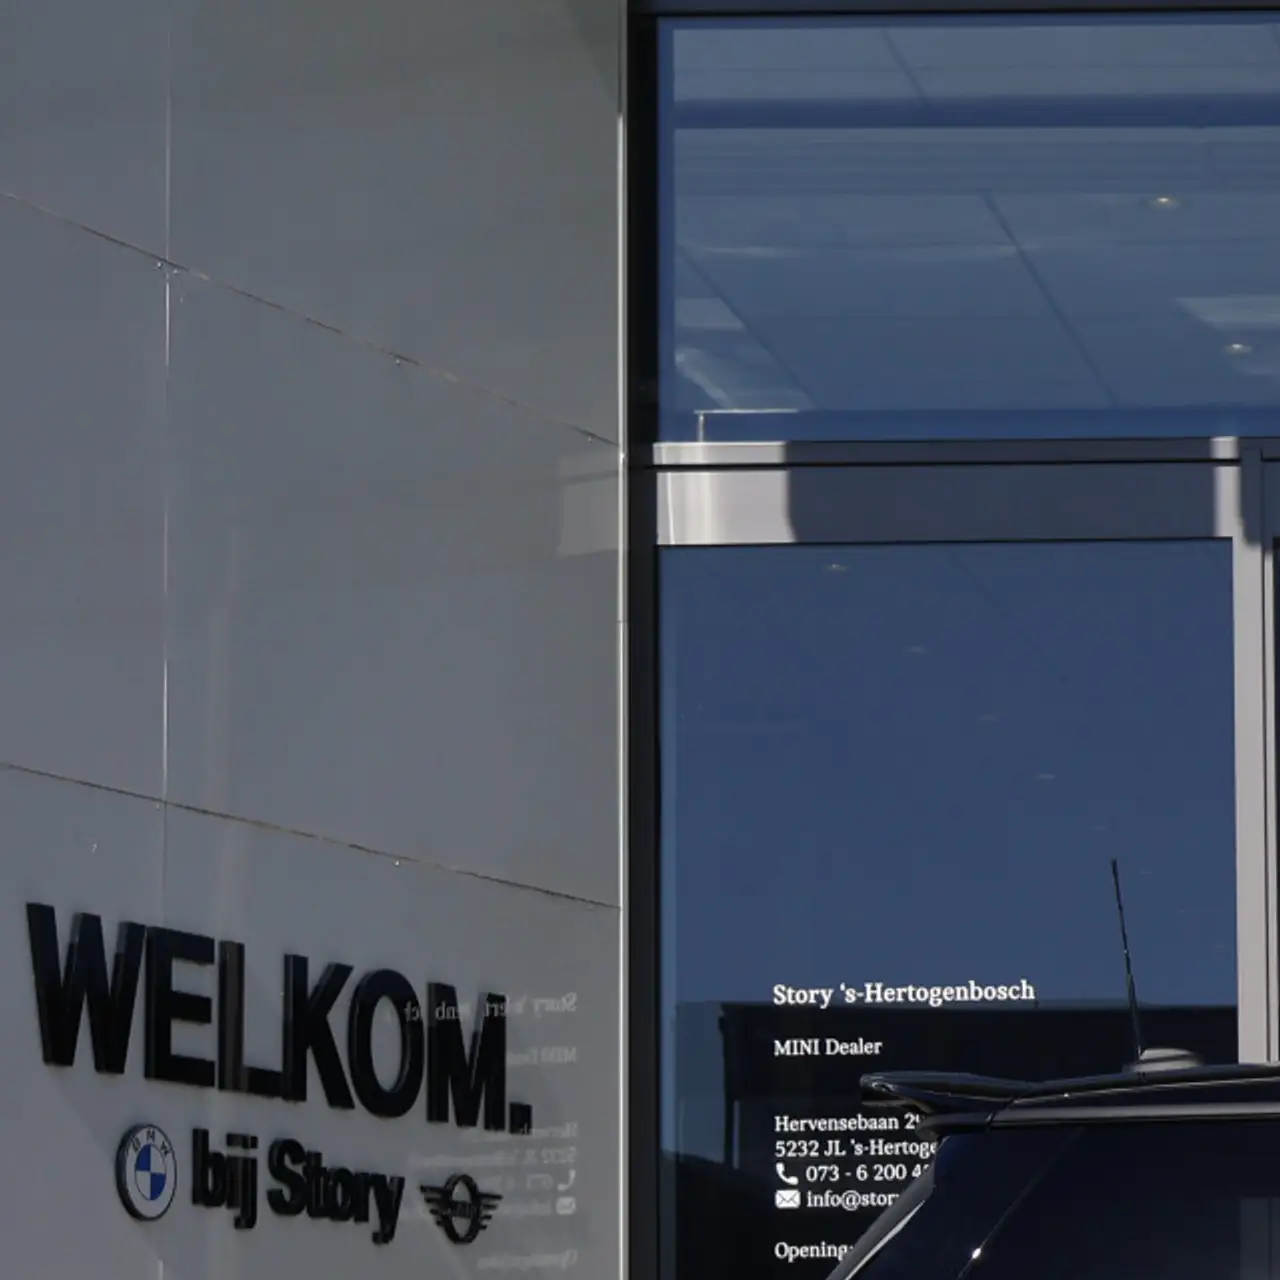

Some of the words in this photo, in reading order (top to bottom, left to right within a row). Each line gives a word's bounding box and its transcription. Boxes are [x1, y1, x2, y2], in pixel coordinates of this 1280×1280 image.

[773, 983, 834, 1009] Story
[839, 978, 1036, 1007] 's-Hertogenbosch
[26, 902, 533, 1135] WELKOM.
[774, 1038, 820, 1056] MINI
[825, 1037, 883, 1056] Dealer
[774, 1113, 899, 1133] Hervensebaan
[775, 1140, 820, 1158] 5232
[823, 1139, 847, 1157] JL
[805, 1164, 840, 1182] 073
[856, 1164, 869, 1181] 6
[873, 1163, 908, 1181] 200
[911, 1163, 930, 1179] 4
[192, 1128, 258, 1230] bij
[267, 1137, 405, 1245] Story
[806, 1188, 900, 1211] info@stor
[774, 1240, 854, 1263] Opening
